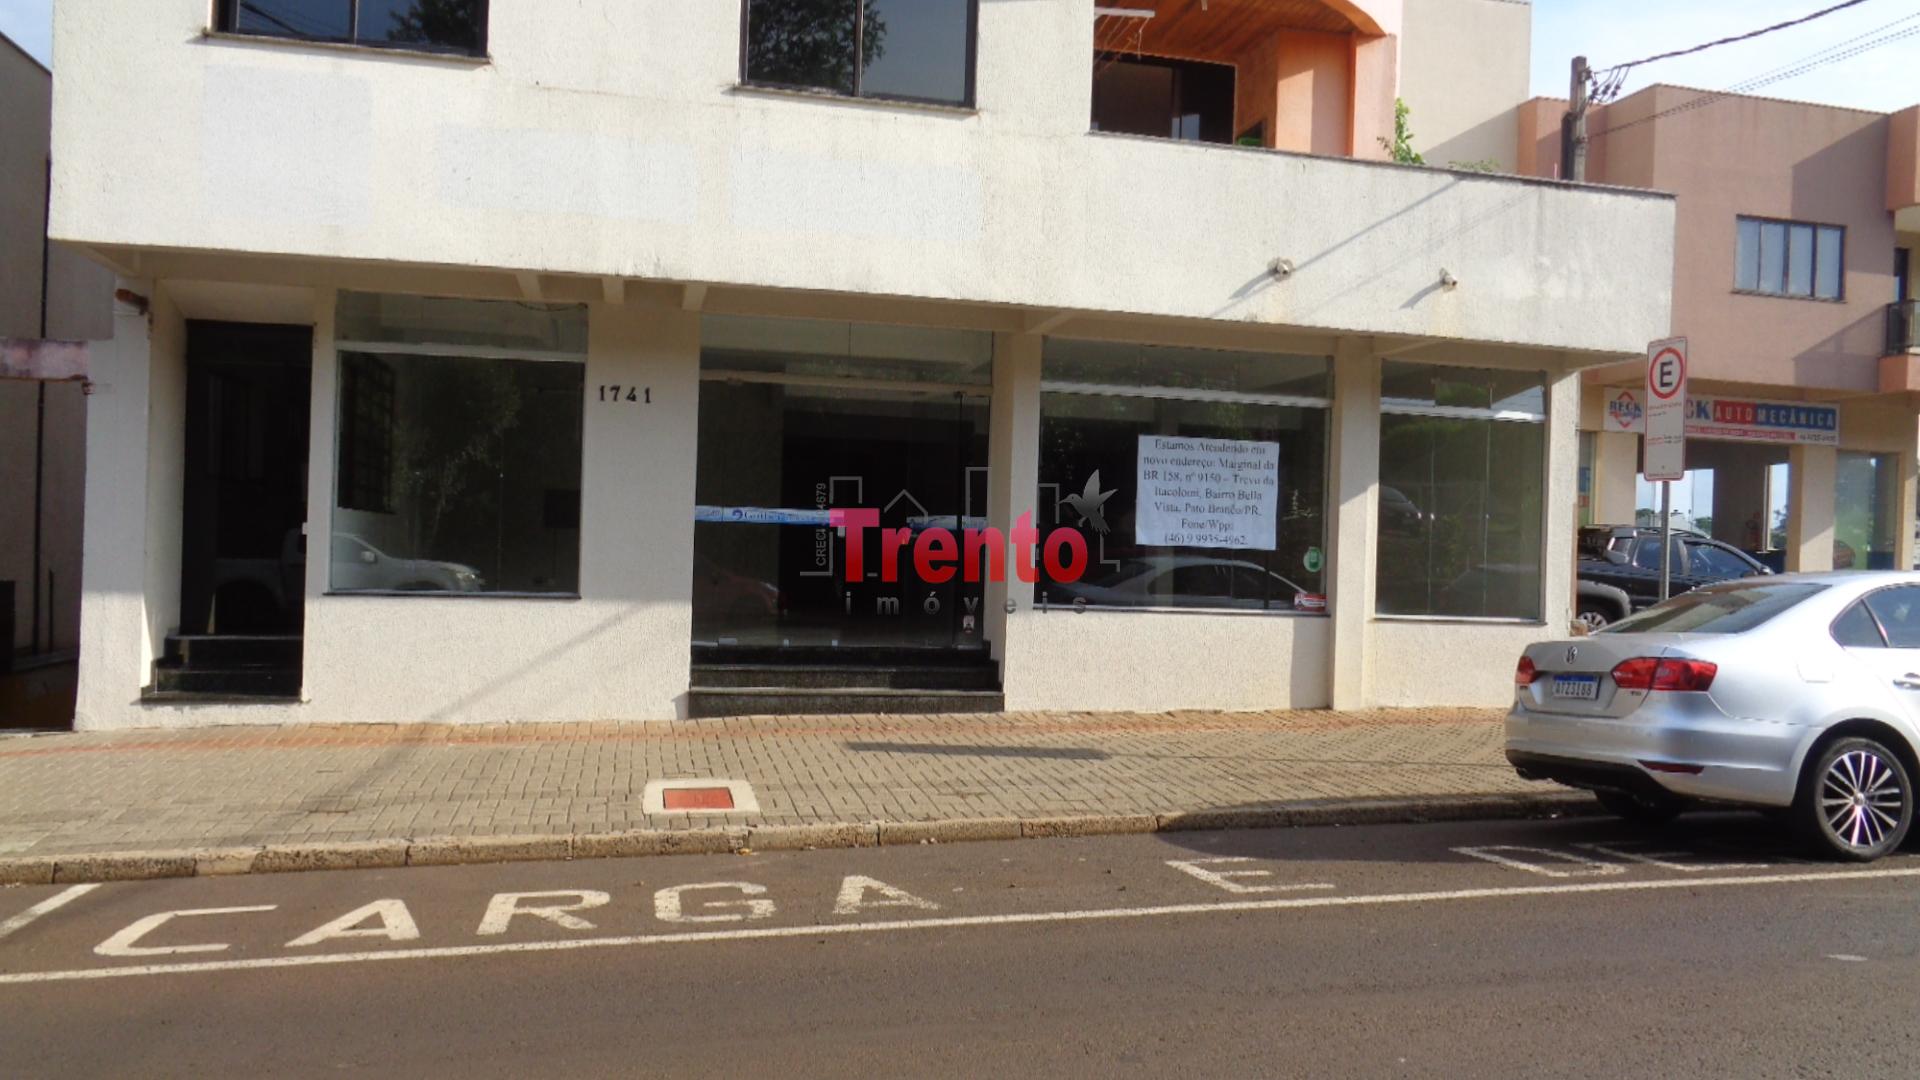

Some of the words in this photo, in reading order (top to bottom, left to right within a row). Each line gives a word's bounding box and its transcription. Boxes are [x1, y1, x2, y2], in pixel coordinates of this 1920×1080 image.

[1659, 360, 1673, 388] E
[599, 385, 651, 404] 1741
[1155, 439, 1194, 451] Estamos
[1250, 446, 1266, 455] em
[1143, 456, 1167, 465] novo
[1219, 458, 1261, 471] Marginal
[1143, 470, 1158, 480] BR
[1232, 474, 1260, 485] Trevo
[1205, 488, 1236, 500] Bairro
[1237, 489, 1263, 500] Bella
[1185, 503, 1205, 514] Pato
[94, 875, 941, 957] CARGA
